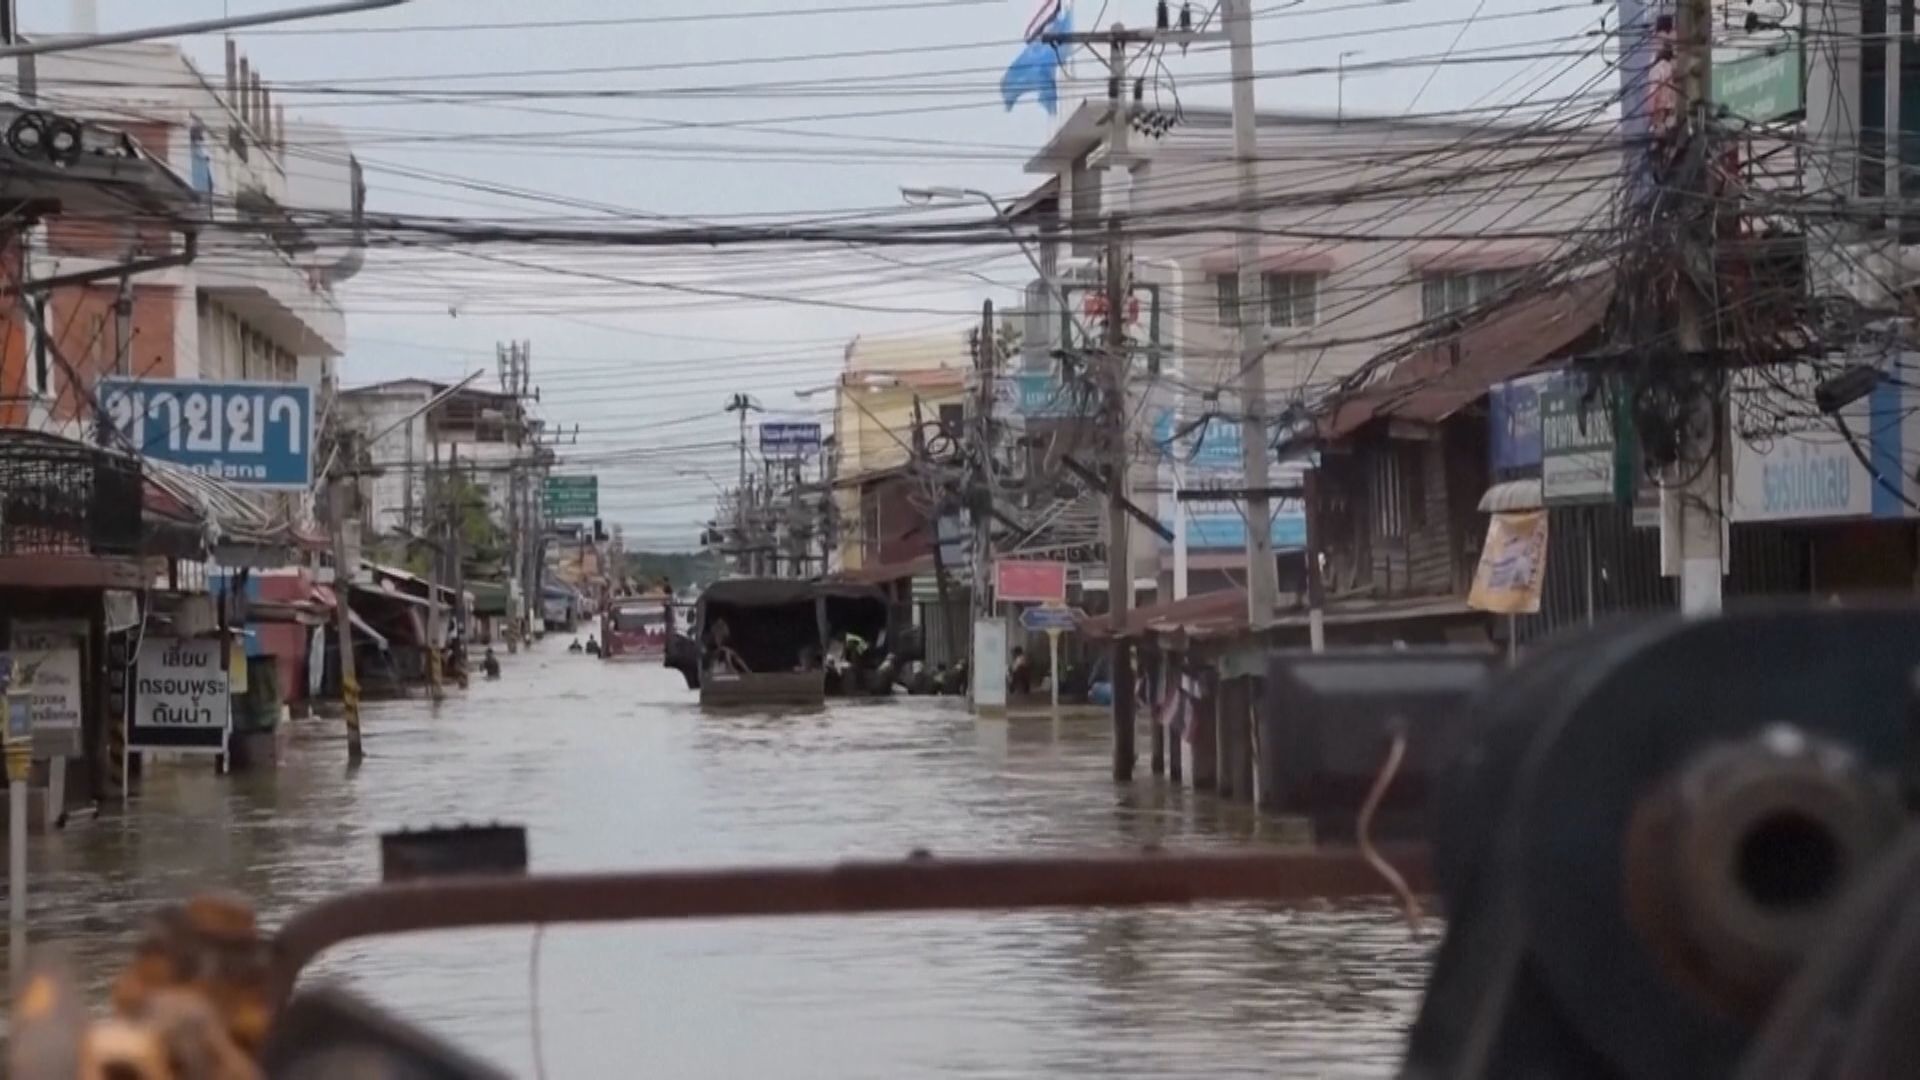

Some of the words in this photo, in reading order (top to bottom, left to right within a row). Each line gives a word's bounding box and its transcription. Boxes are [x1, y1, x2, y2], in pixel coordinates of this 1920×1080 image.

[105, 390, 301, 455] ขายยา
[138, 678, 225, 696] กรอบพระ
[152, 697, 211, 724] กันน้ำ
